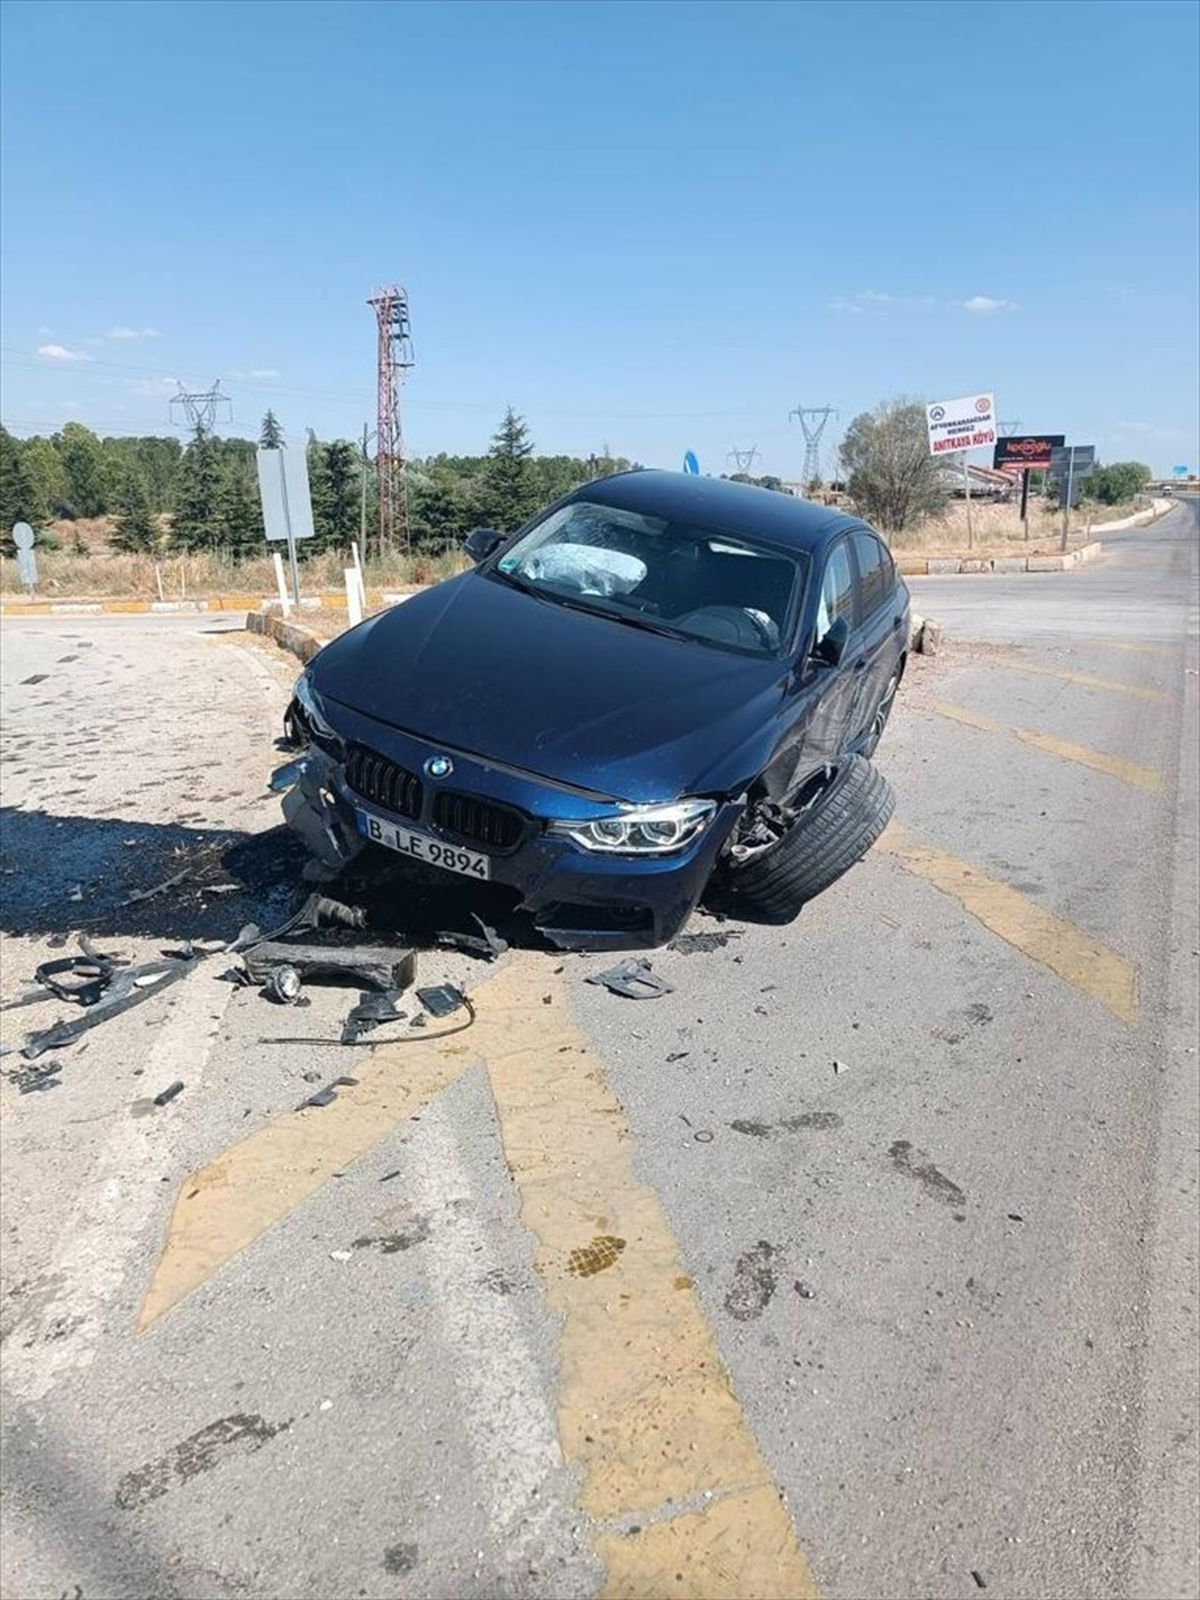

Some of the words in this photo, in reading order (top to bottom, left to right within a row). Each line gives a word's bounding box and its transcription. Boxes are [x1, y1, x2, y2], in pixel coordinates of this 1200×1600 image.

[933, 435, 971, 452] ANITKAYA
[973, 429, 995, 445] KÖYÜ
[369, 819, 383, 840] B
[395, 830, 424, 859] LE
[428, 843, 486, 877] 9894
